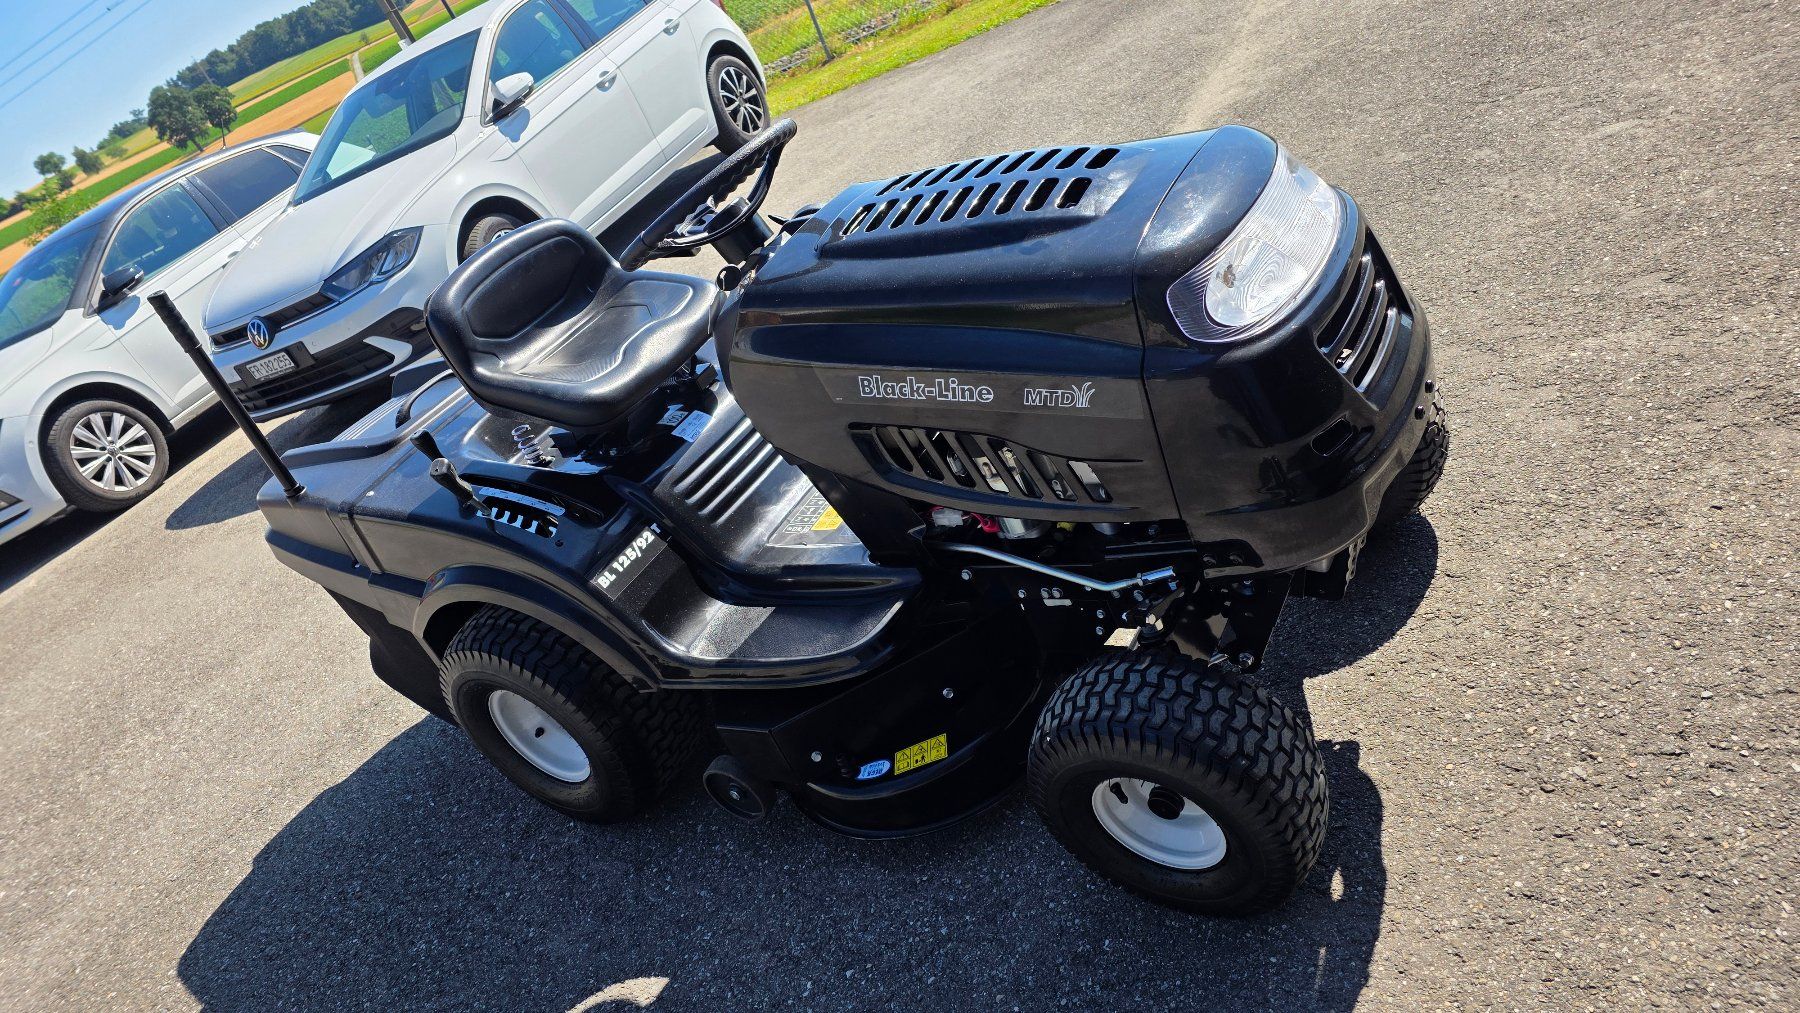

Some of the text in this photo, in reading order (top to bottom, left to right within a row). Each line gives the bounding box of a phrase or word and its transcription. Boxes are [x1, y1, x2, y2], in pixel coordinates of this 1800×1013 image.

[858, 375, 994, 403] Black-Line
[1023, 388, 1077, 408] MTD
[597, 571, 617, 589] BL
[612, 531, 655, 572] 125/92
